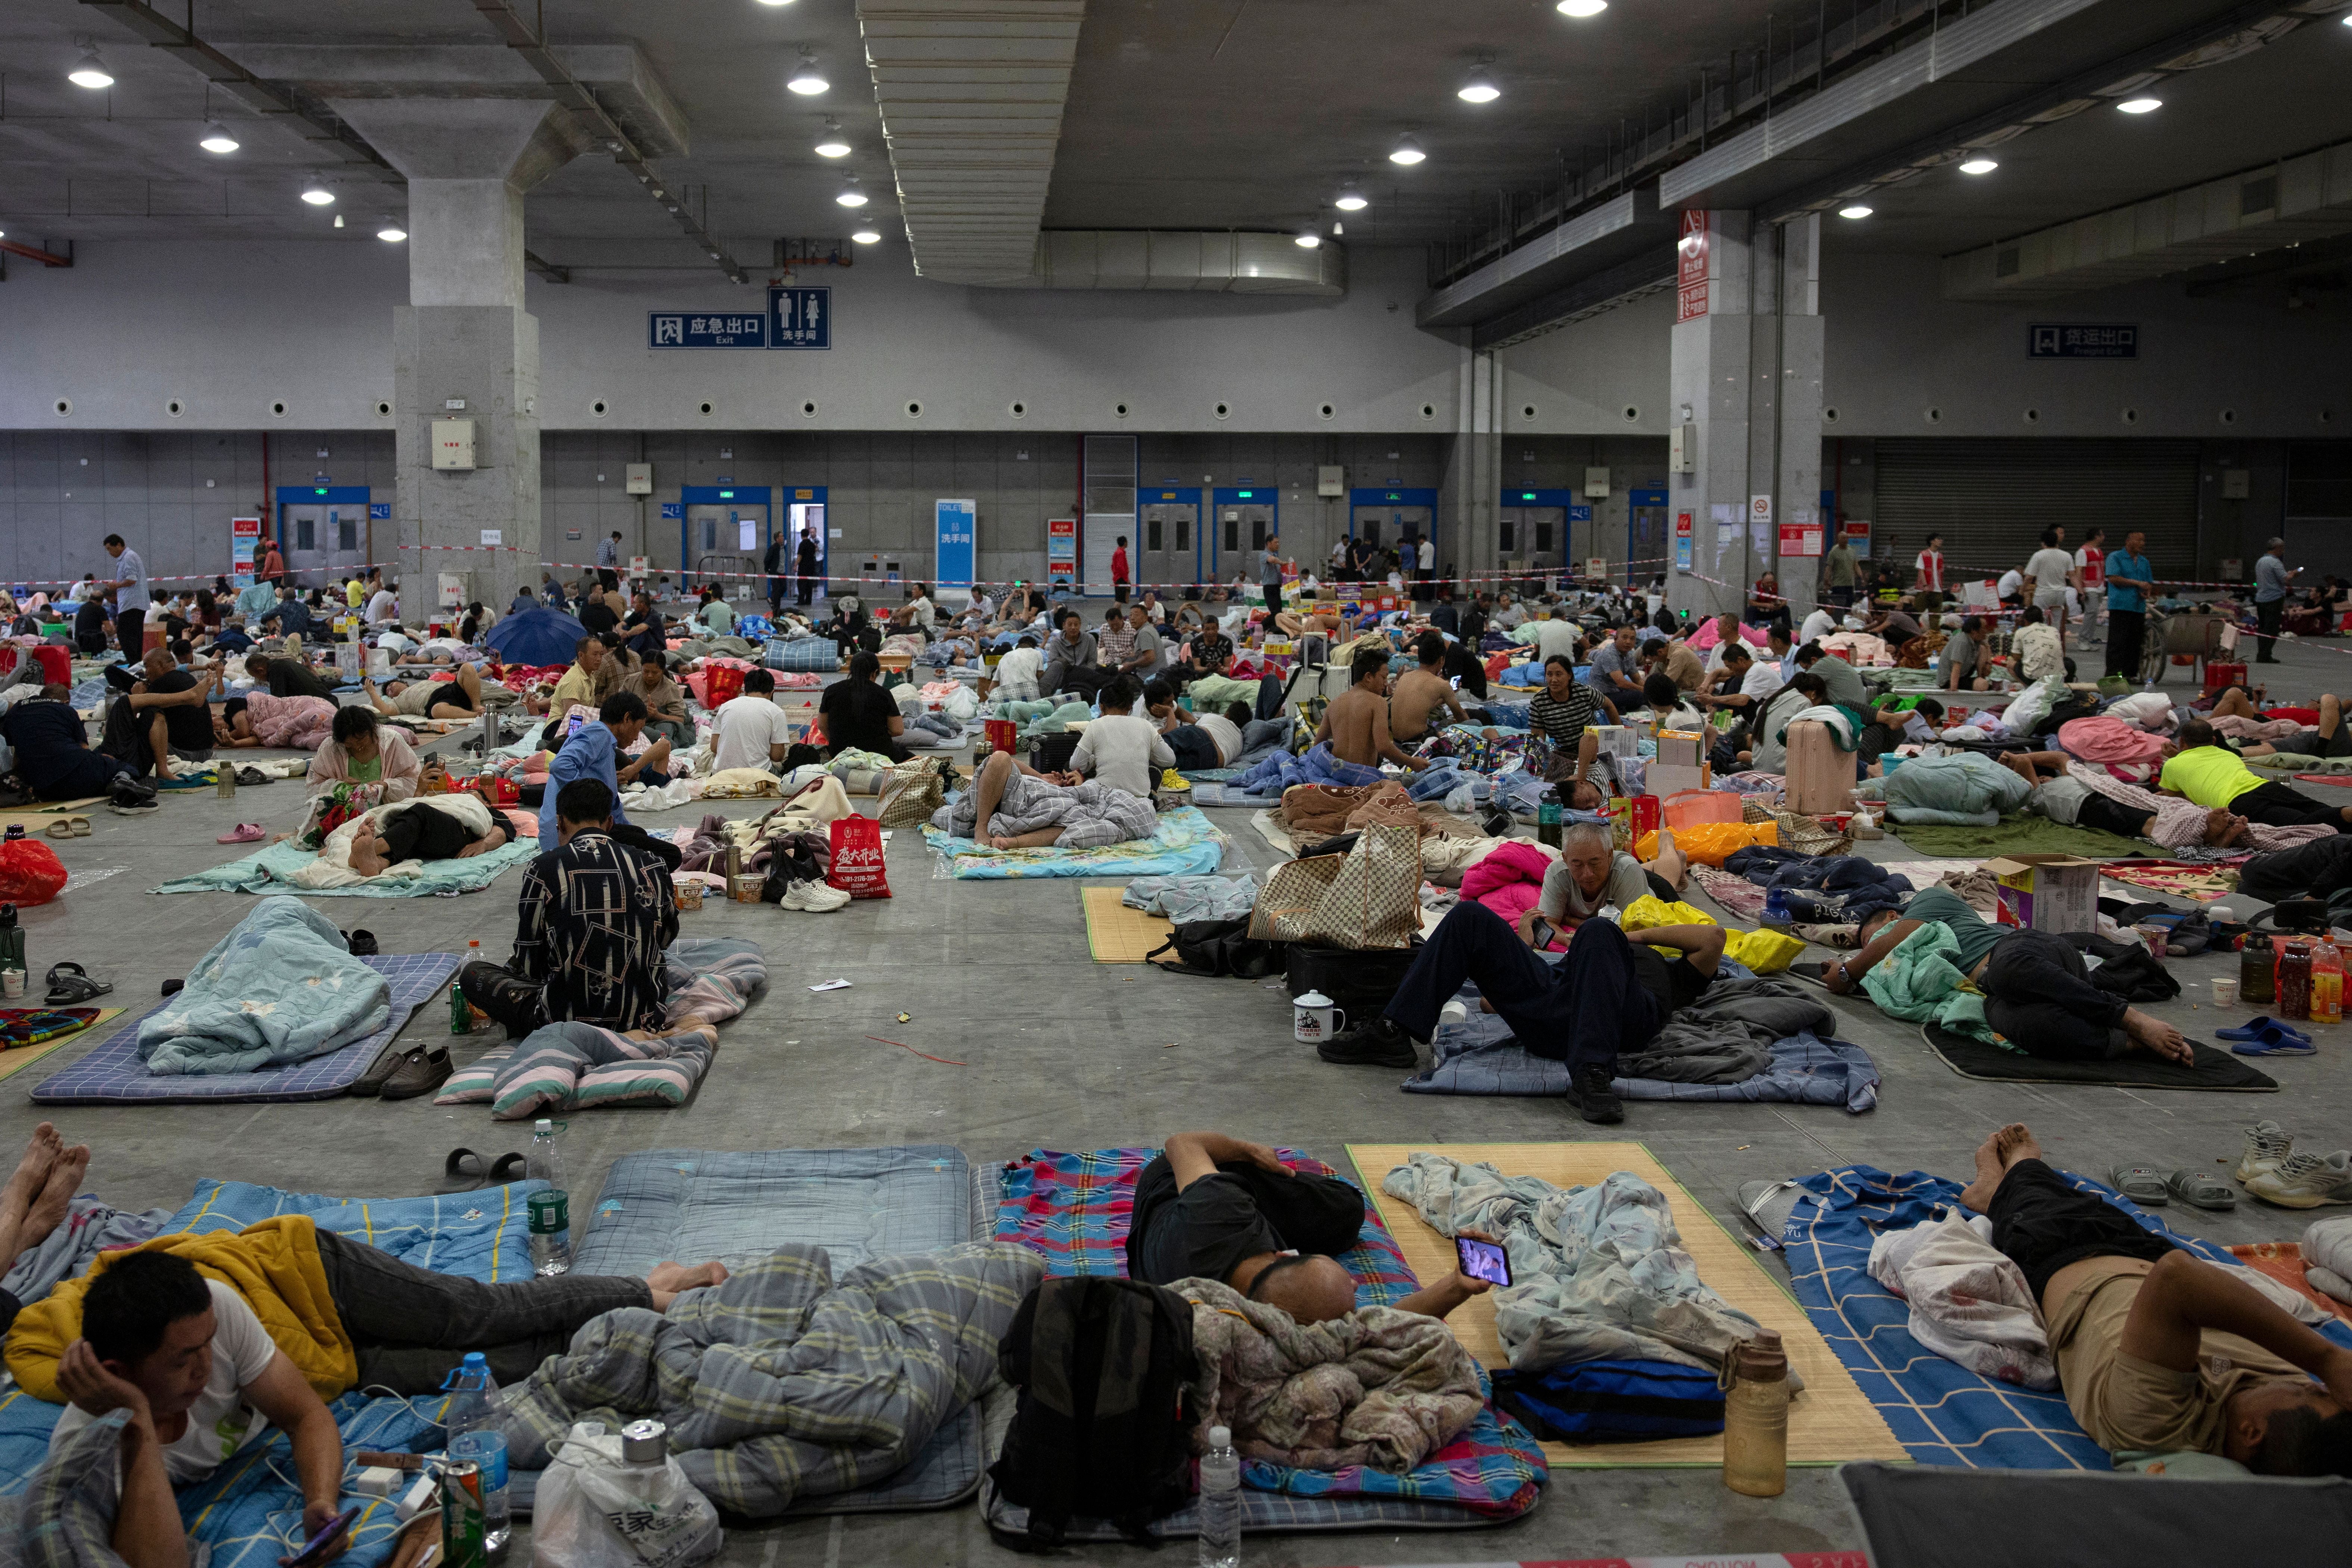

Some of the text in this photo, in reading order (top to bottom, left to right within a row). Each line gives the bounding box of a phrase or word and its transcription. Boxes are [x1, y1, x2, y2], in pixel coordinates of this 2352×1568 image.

[690, 317, 758, 334] 应急出口
[716, 336, 734, 344] Exit
[782, 330, 816, 341] 洗手间
[2065, 328, 2133, 346] 货运出口
[941, 533, 970, 544] 洗手间
[836, 845, 881, 866] 盛大开业
[1814, 903, 1839, 918] BIG
